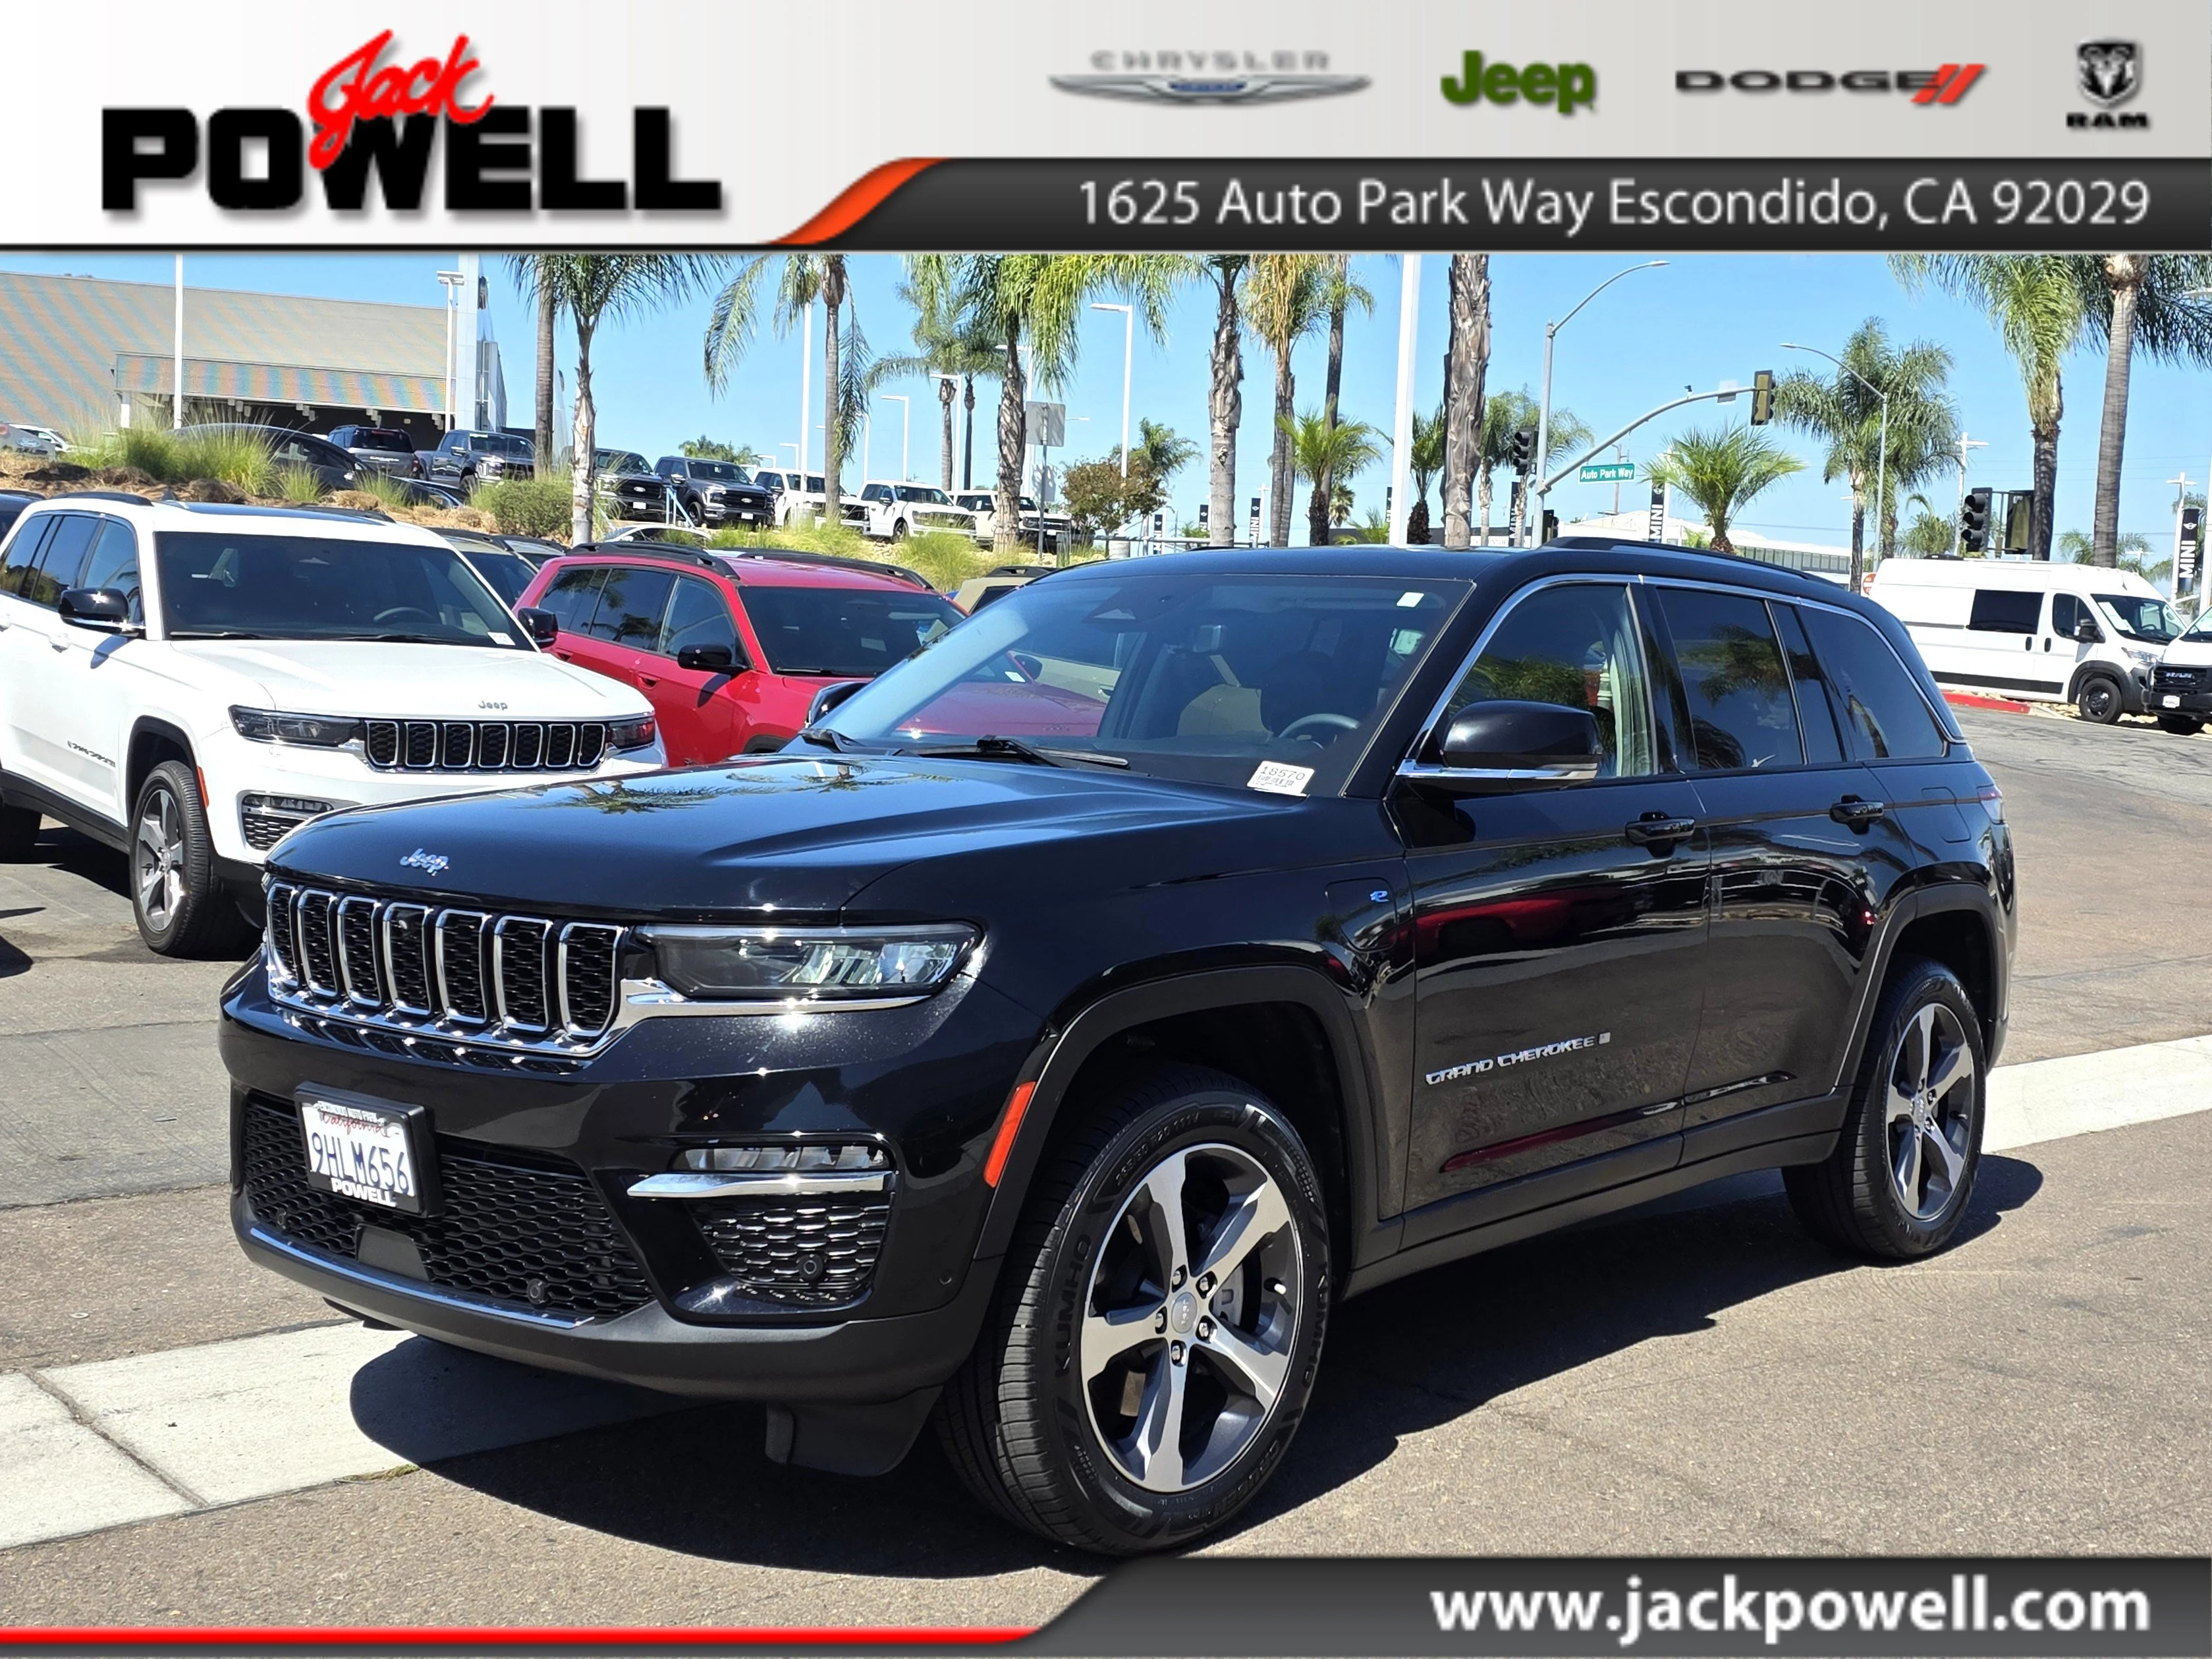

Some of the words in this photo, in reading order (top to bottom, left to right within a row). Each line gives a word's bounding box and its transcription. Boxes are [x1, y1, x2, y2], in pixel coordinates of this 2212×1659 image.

[1581, 470, 1598, 480] Auto
[1599, 468, 1616, 478] Park
[1618, 468, 1634, 479] Way
[1649, 504, 1663, 539] MINI
[2178, 540, 2196, 578] MINI
[478, 700, 508, 711] Jeep
[1260, 766, 1306, 781] 18570
[400, 848, 449, 876] Jeep
[1425, 1058, 1494, 1086] GRAND
[1497, 1035, 1596, 1068] CHEROKEE
[312, 1132, 409, 1195] 9HLM656
[331, 1177, 397, 1208] POWELL
[1055, 1233, 1092, 1378] KUMHO
